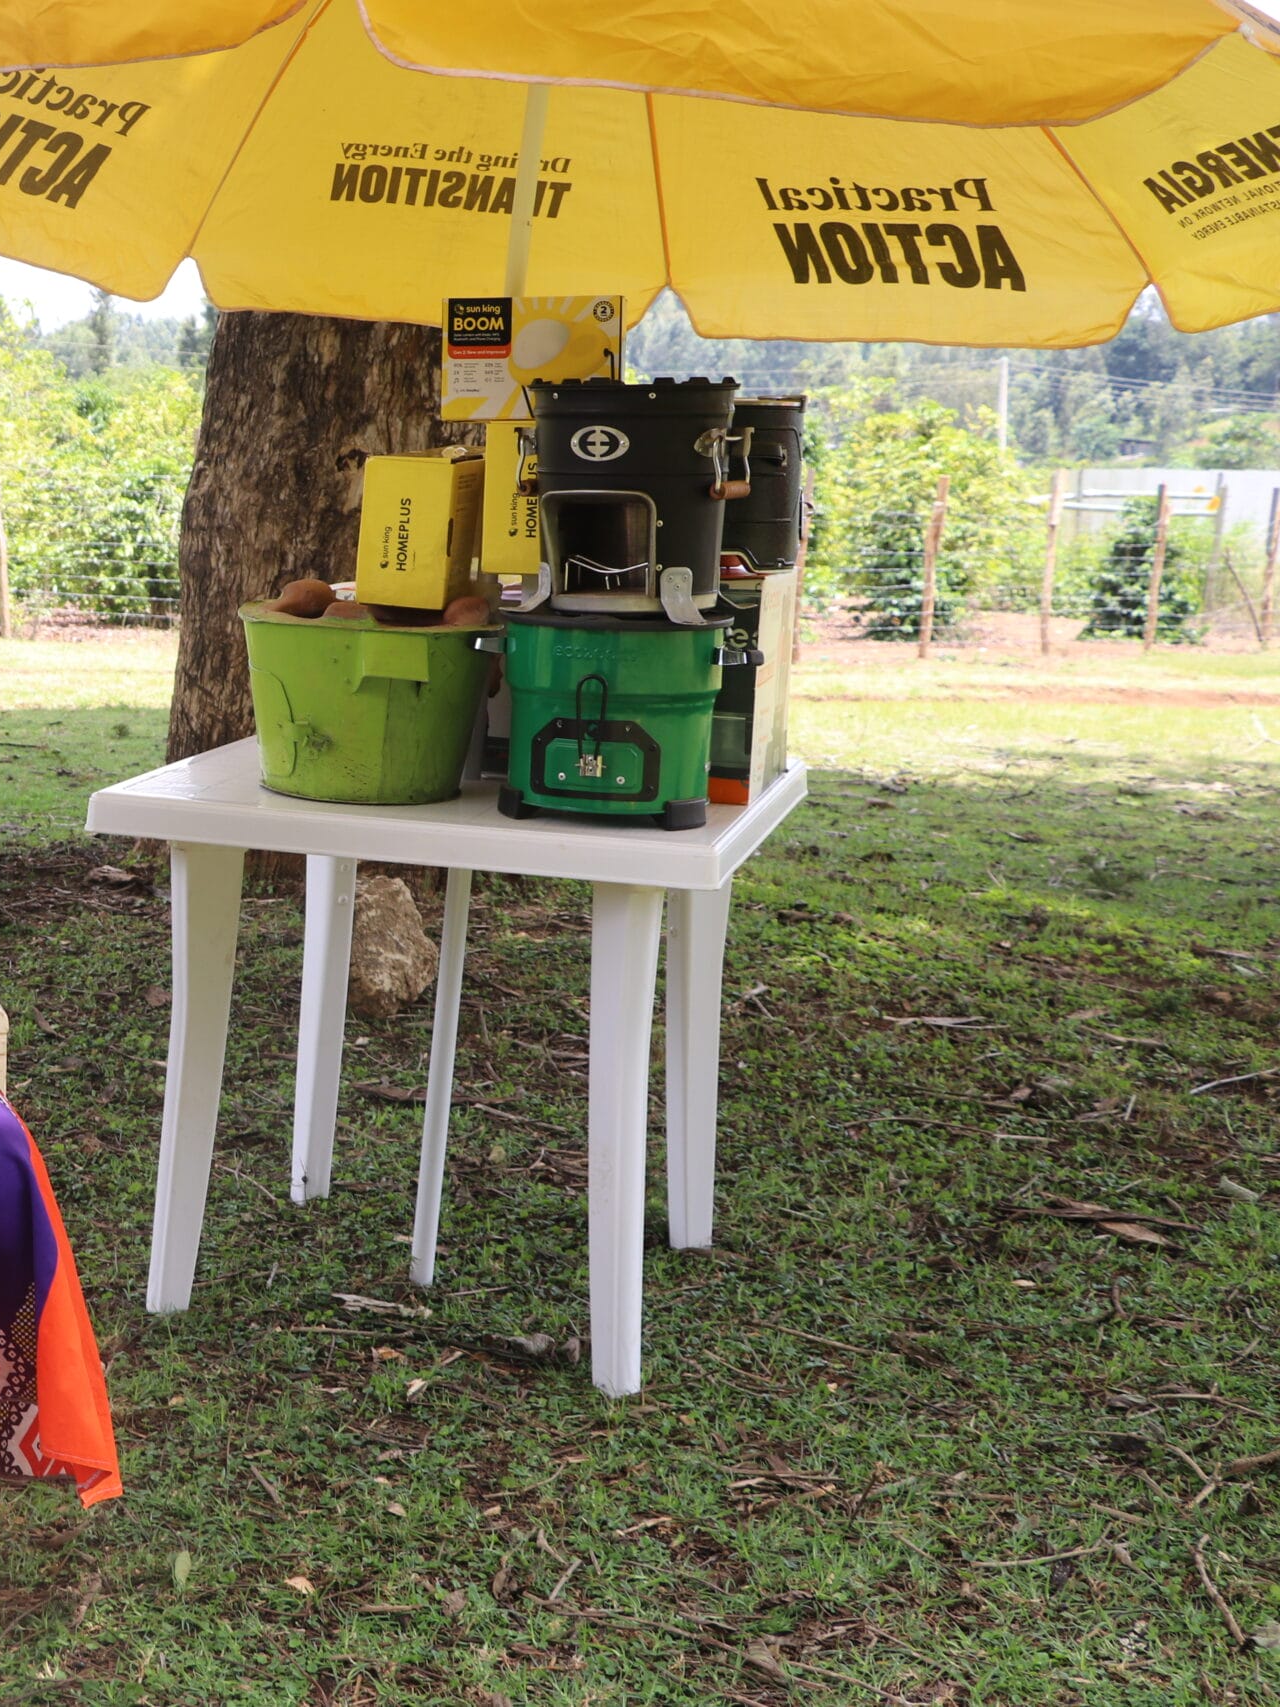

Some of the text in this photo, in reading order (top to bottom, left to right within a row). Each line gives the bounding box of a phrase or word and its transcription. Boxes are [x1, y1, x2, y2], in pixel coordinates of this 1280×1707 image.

[482, 304, 501, 314] king
[600, 305, 608, 314] 2
[453, 317, 504, 331] BOOM
[510, 492, 520, 511] king
[526, 462, 538, 538] HOMEUS
[382, 526, 393, 544] king
[395, 497, 412, 572] HOMEPLUS
